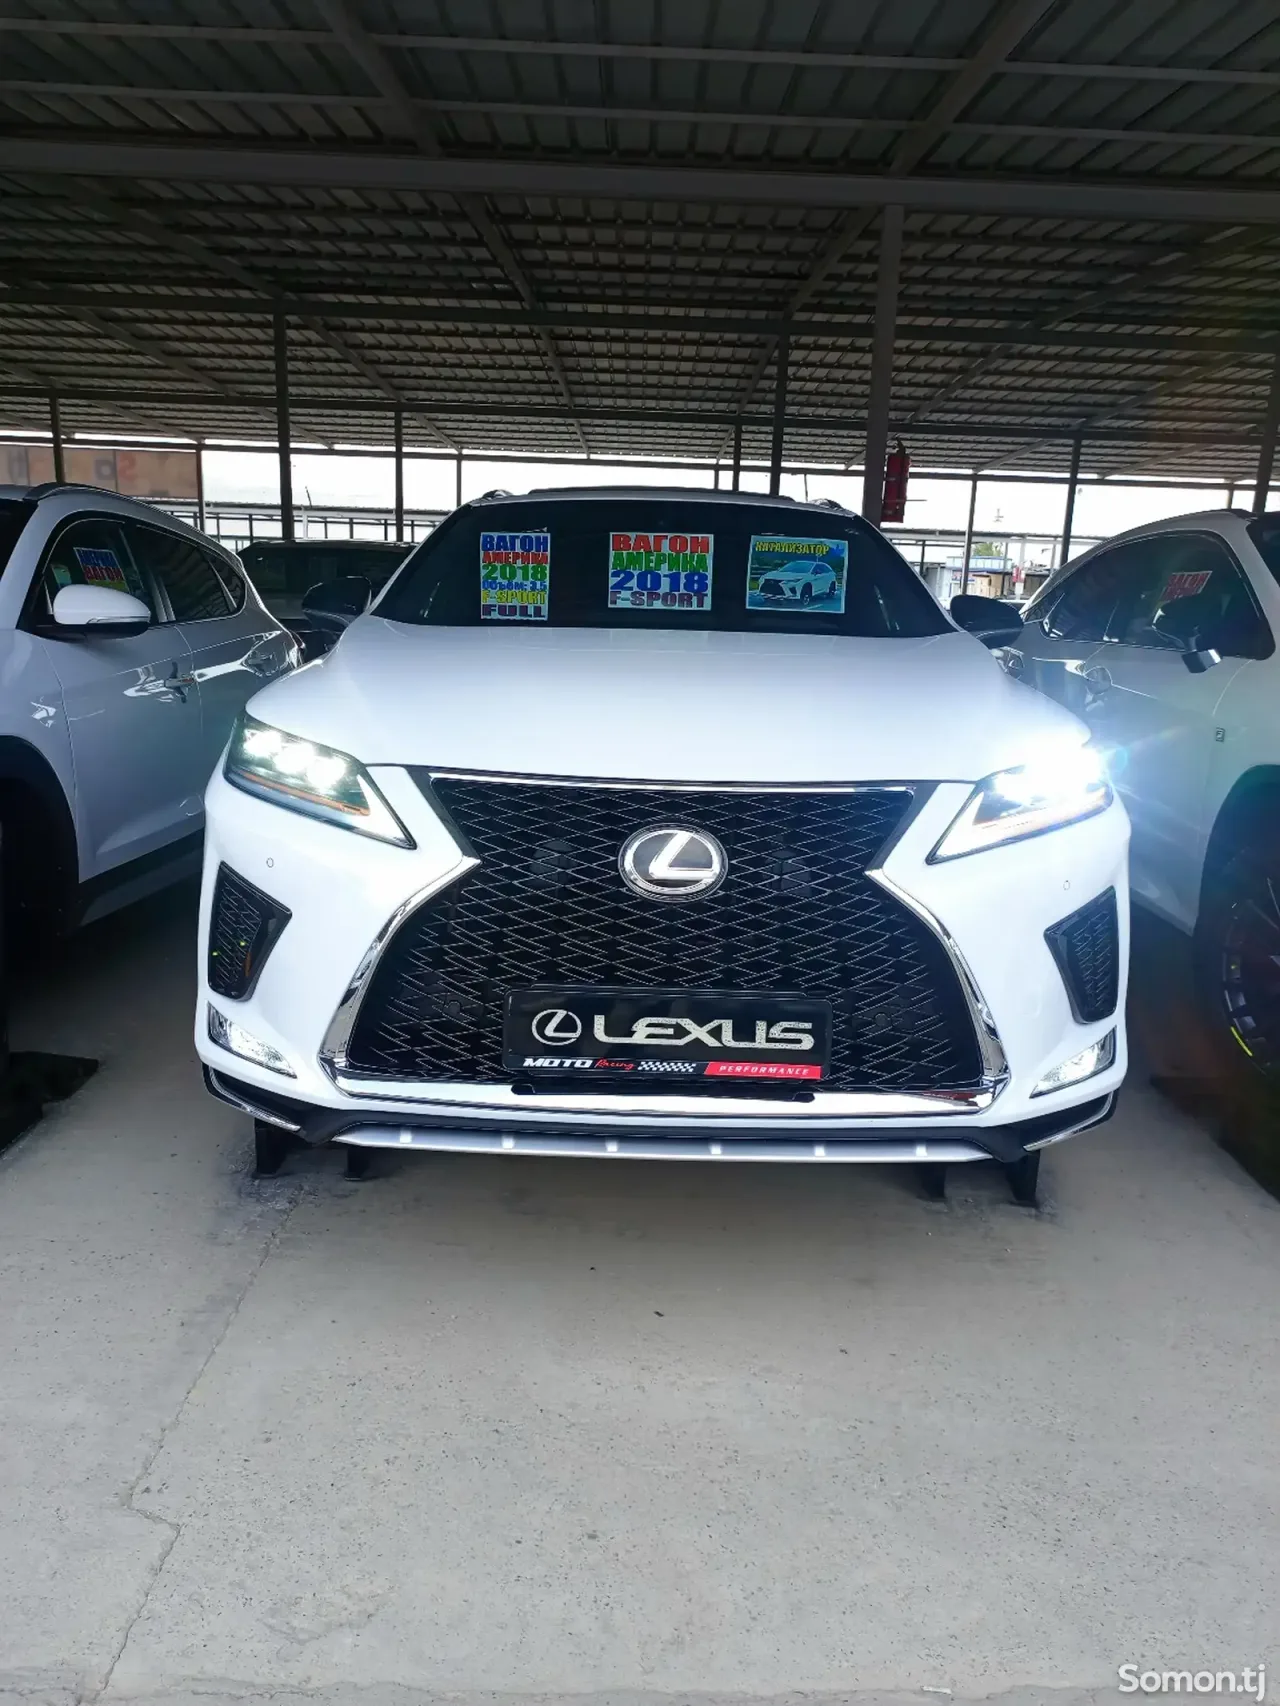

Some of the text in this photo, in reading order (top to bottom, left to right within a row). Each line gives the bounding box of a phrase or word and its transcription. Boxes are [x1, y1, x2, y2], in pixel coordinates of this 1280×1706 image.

[481, 534, 549, 552] ВАГОН
[611, 534, 710, 554] ВАГОН
[755, 541, 830, 555] КАТАЛИЗАТОР
[482, 552, 548, 565] АМЕРИКА
[611, 552, 709, 573] АМЕРИКА
[482, 564, 548, 581] 2018
[610, 570, 709, 593] 2018
[482, 590, 547, 604] F-SPORT
[609, 591, 709, 608] F-SPORT
[482, 604, 546, 618] FULL
[594, 1014, 815, 1050] LEXUS
[522, 1057, 810, 1076] MOTO Racing PERFORMANCE
